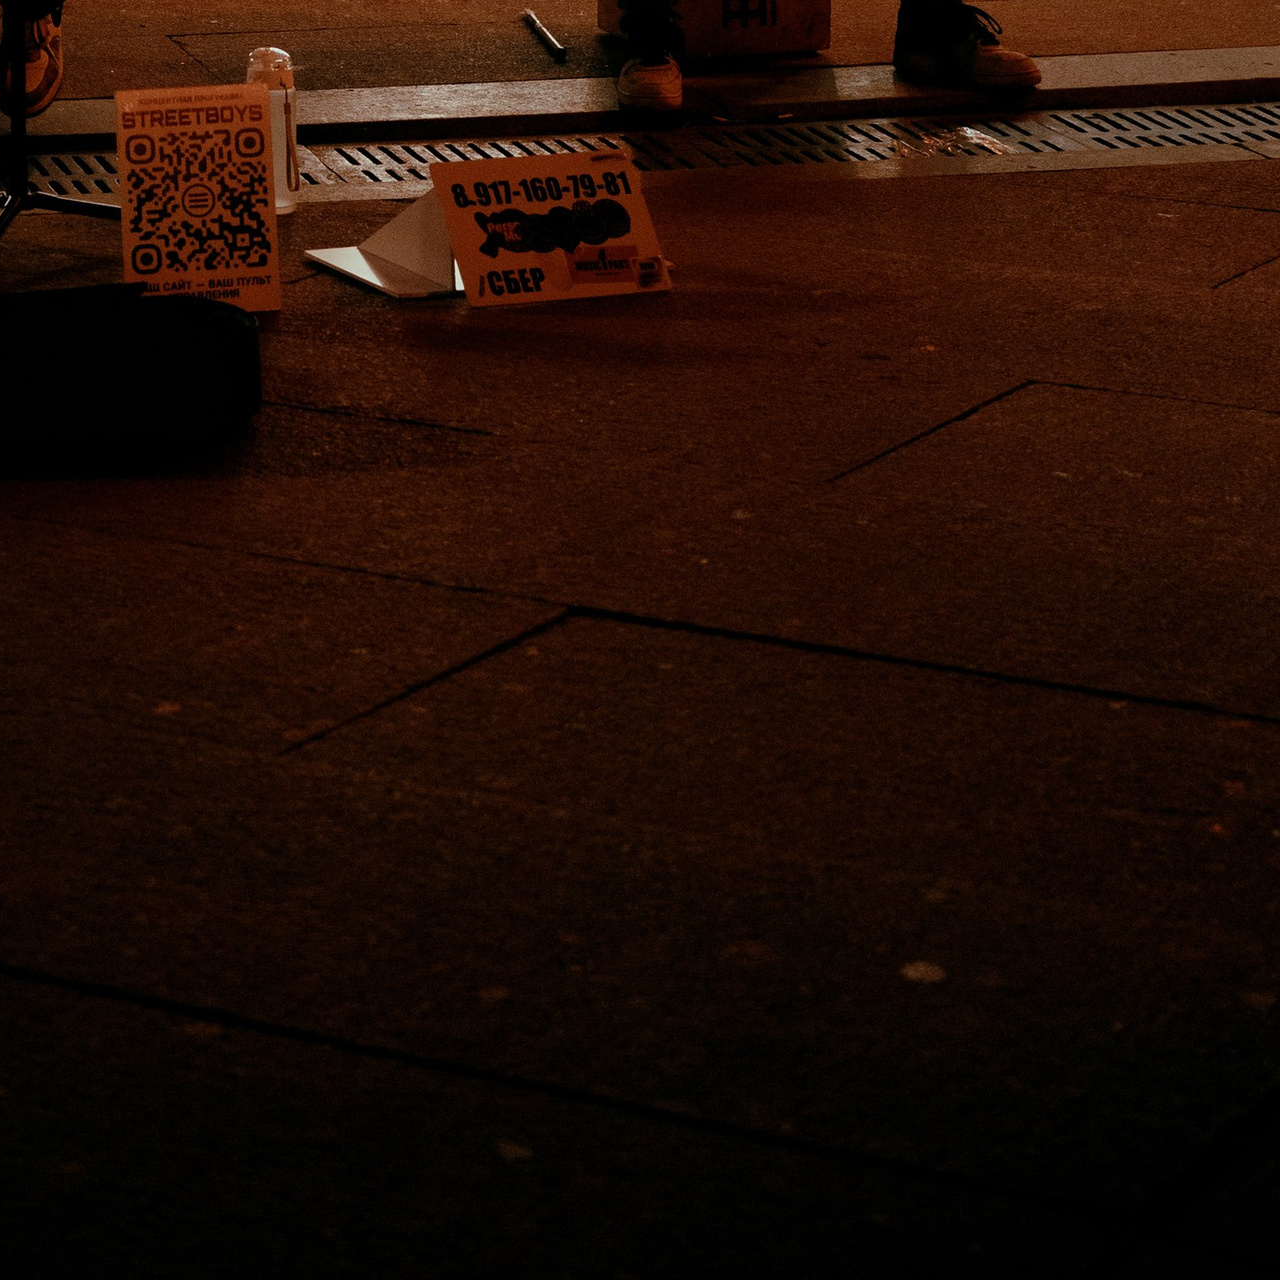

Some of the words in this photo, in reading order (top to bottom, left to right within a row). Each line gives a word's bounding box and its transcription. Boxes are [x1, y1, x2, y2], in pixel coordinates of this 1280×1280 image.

[122, 104, 263, 129] STREETBOYS
[163, 279, 192, 292] САЙТ
[208, 278, 234, 289] ВАШ
[237, 275, 272, 286] ПУЛЬТ
